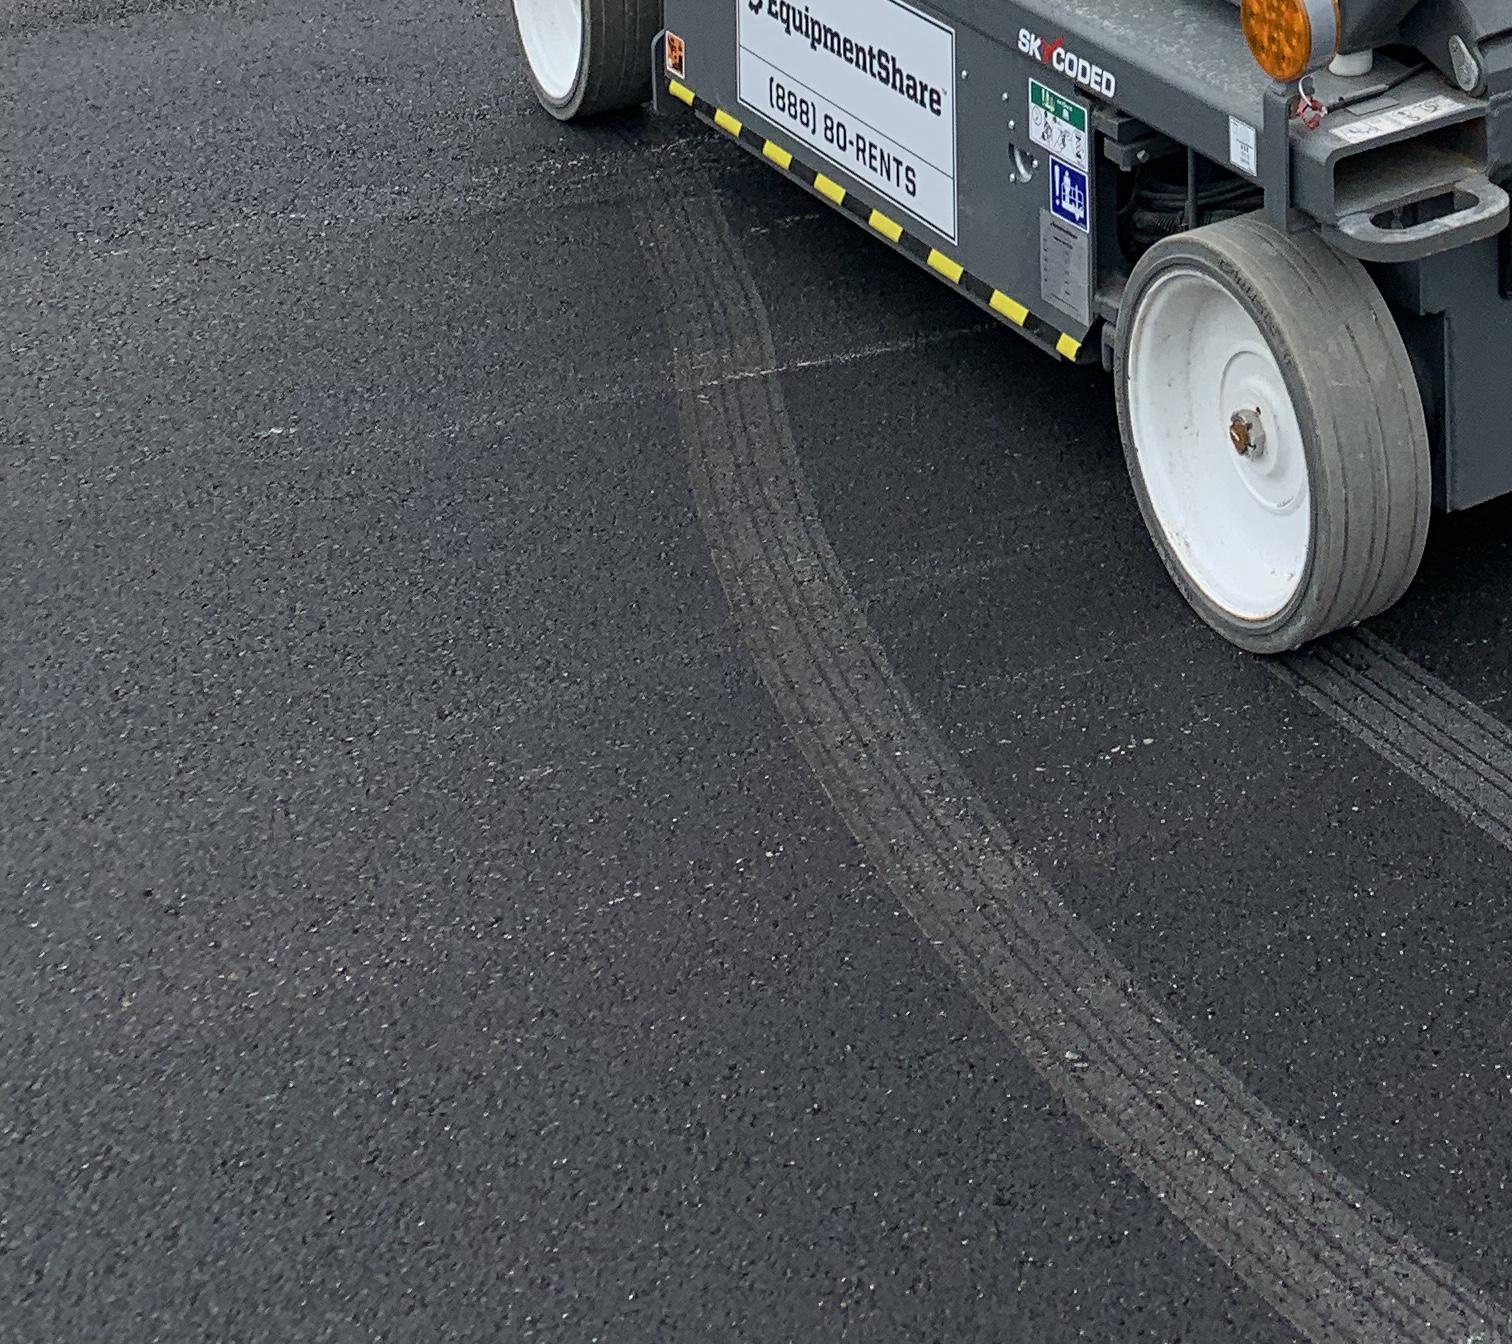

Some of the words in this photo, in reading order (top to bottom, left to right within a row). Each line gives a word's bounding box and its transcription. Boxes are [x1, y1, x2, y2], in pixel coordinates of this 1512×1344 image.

[1017, 27, 1116, 98] SKYCODED
[768, 76, 817, 135] (888)
[824, 114, 917, 198] 80-RENTS
